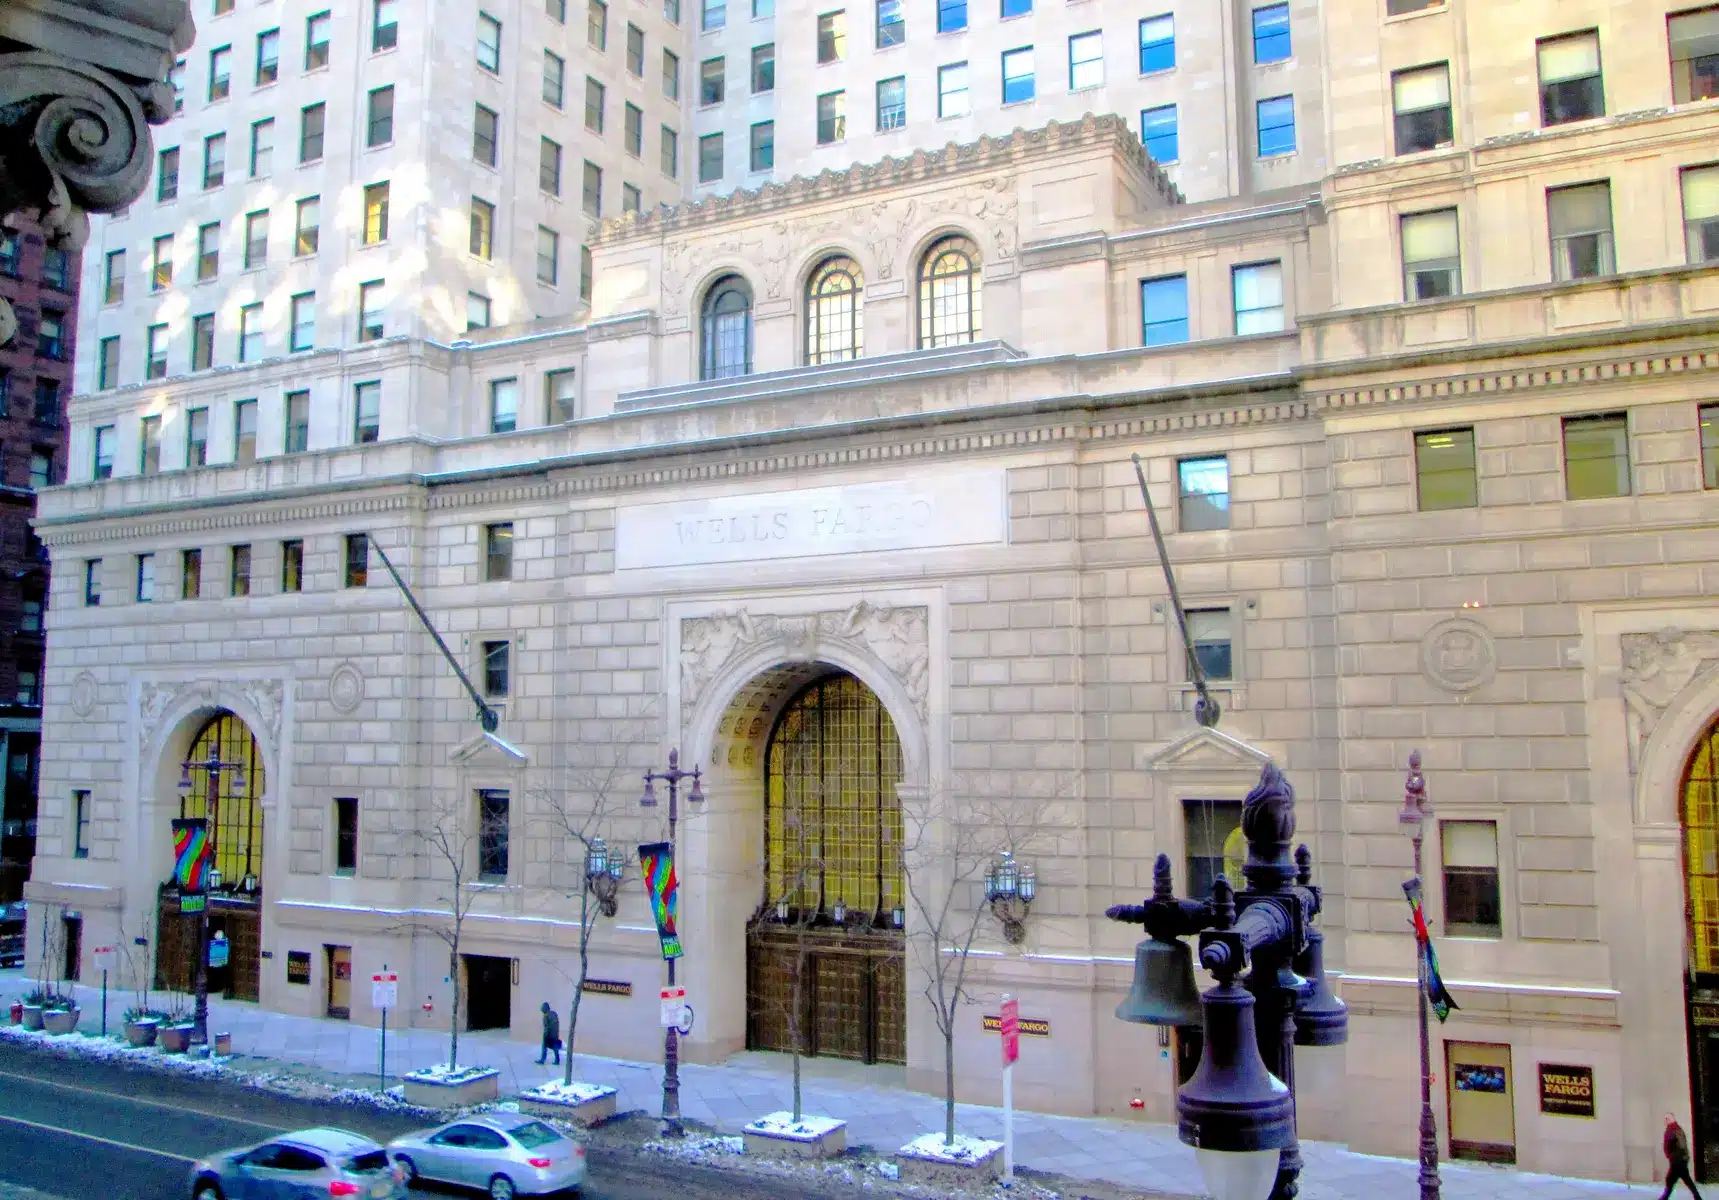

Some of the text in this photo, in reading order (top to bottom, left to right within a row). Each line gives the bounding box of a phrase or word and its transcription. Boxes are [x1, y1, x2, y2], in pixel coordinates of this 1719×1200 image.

[673, 511, 789, 544] WELLS
[1016, 1021, 1049, 1033] FARGO
[1542, 1073, 1590, 1087] WELLS
[1544, 1083, 1591, 1097] FARGO
